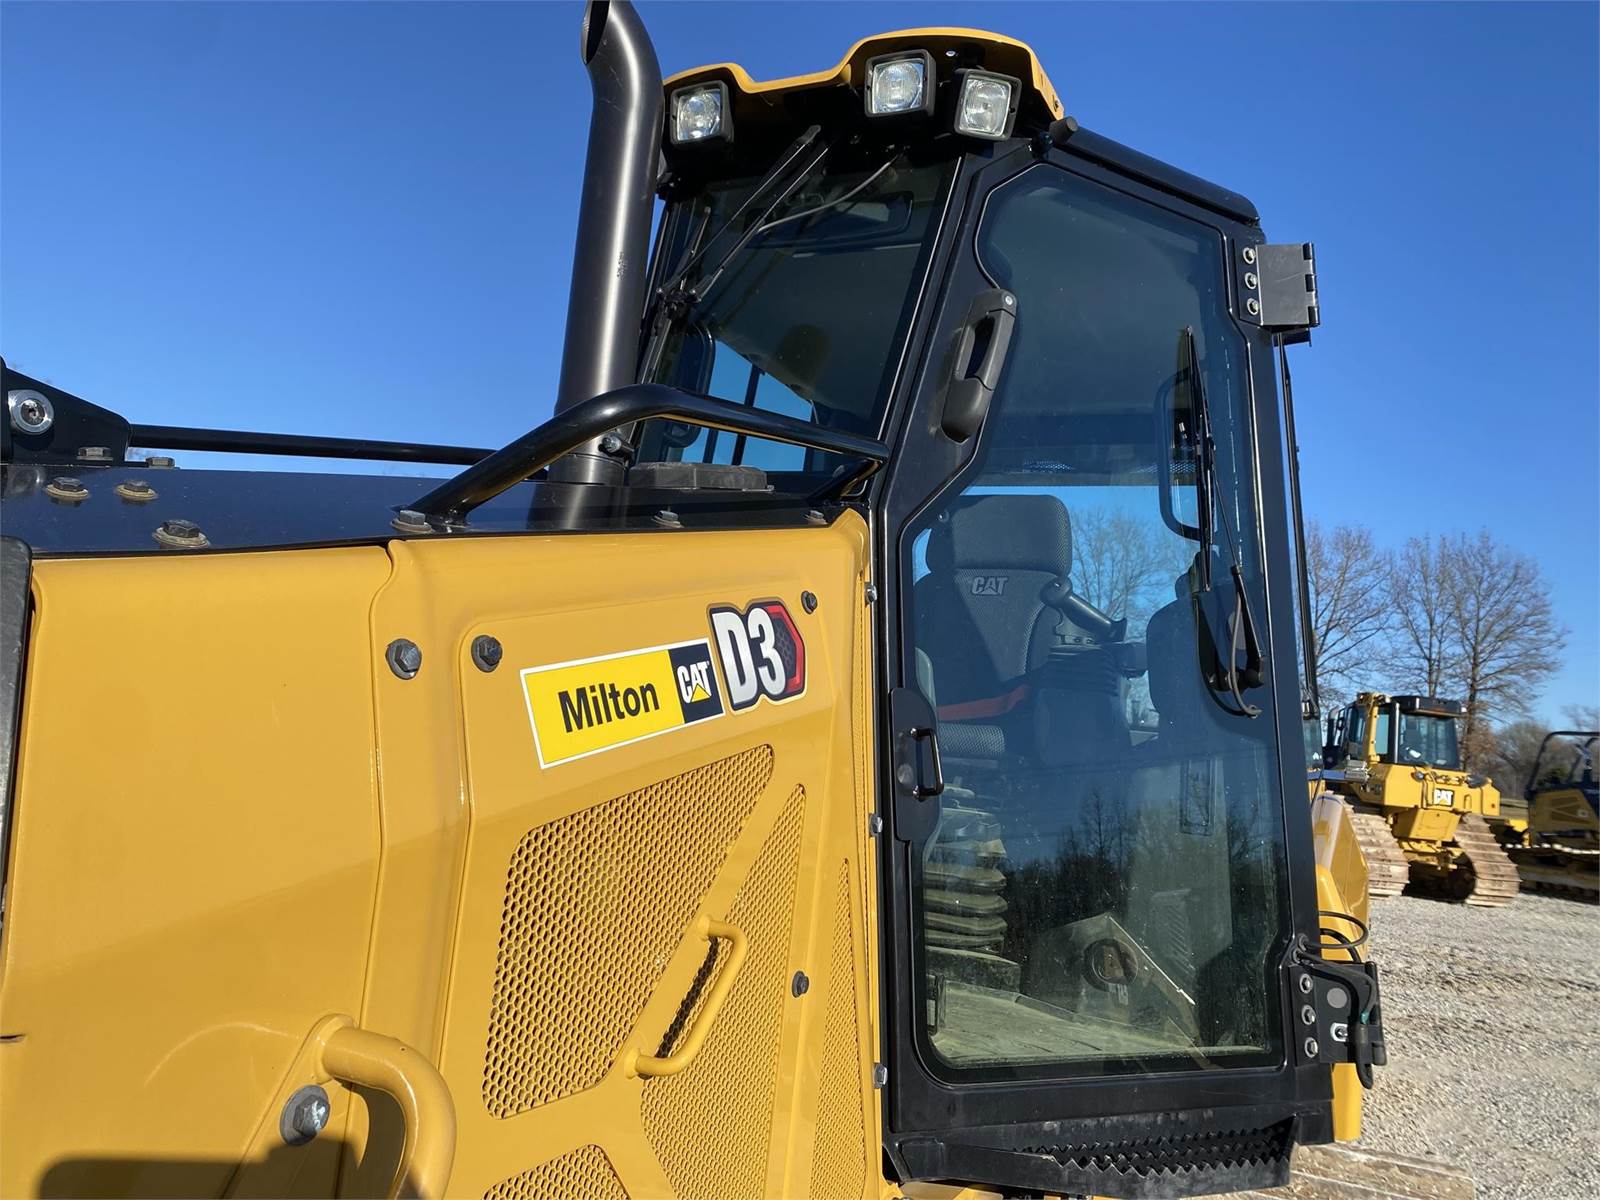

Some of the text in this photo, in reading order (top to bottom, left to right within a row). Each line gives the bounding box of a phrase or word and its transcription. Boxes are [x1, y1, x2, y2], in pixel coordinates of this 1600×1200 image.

[971, 577, 1008, 595] CAT
[712, 607, 787, 705] D3
[557, 661, 712, 733] Milton CAT
[1433, 788, 1454, 806] CAT
